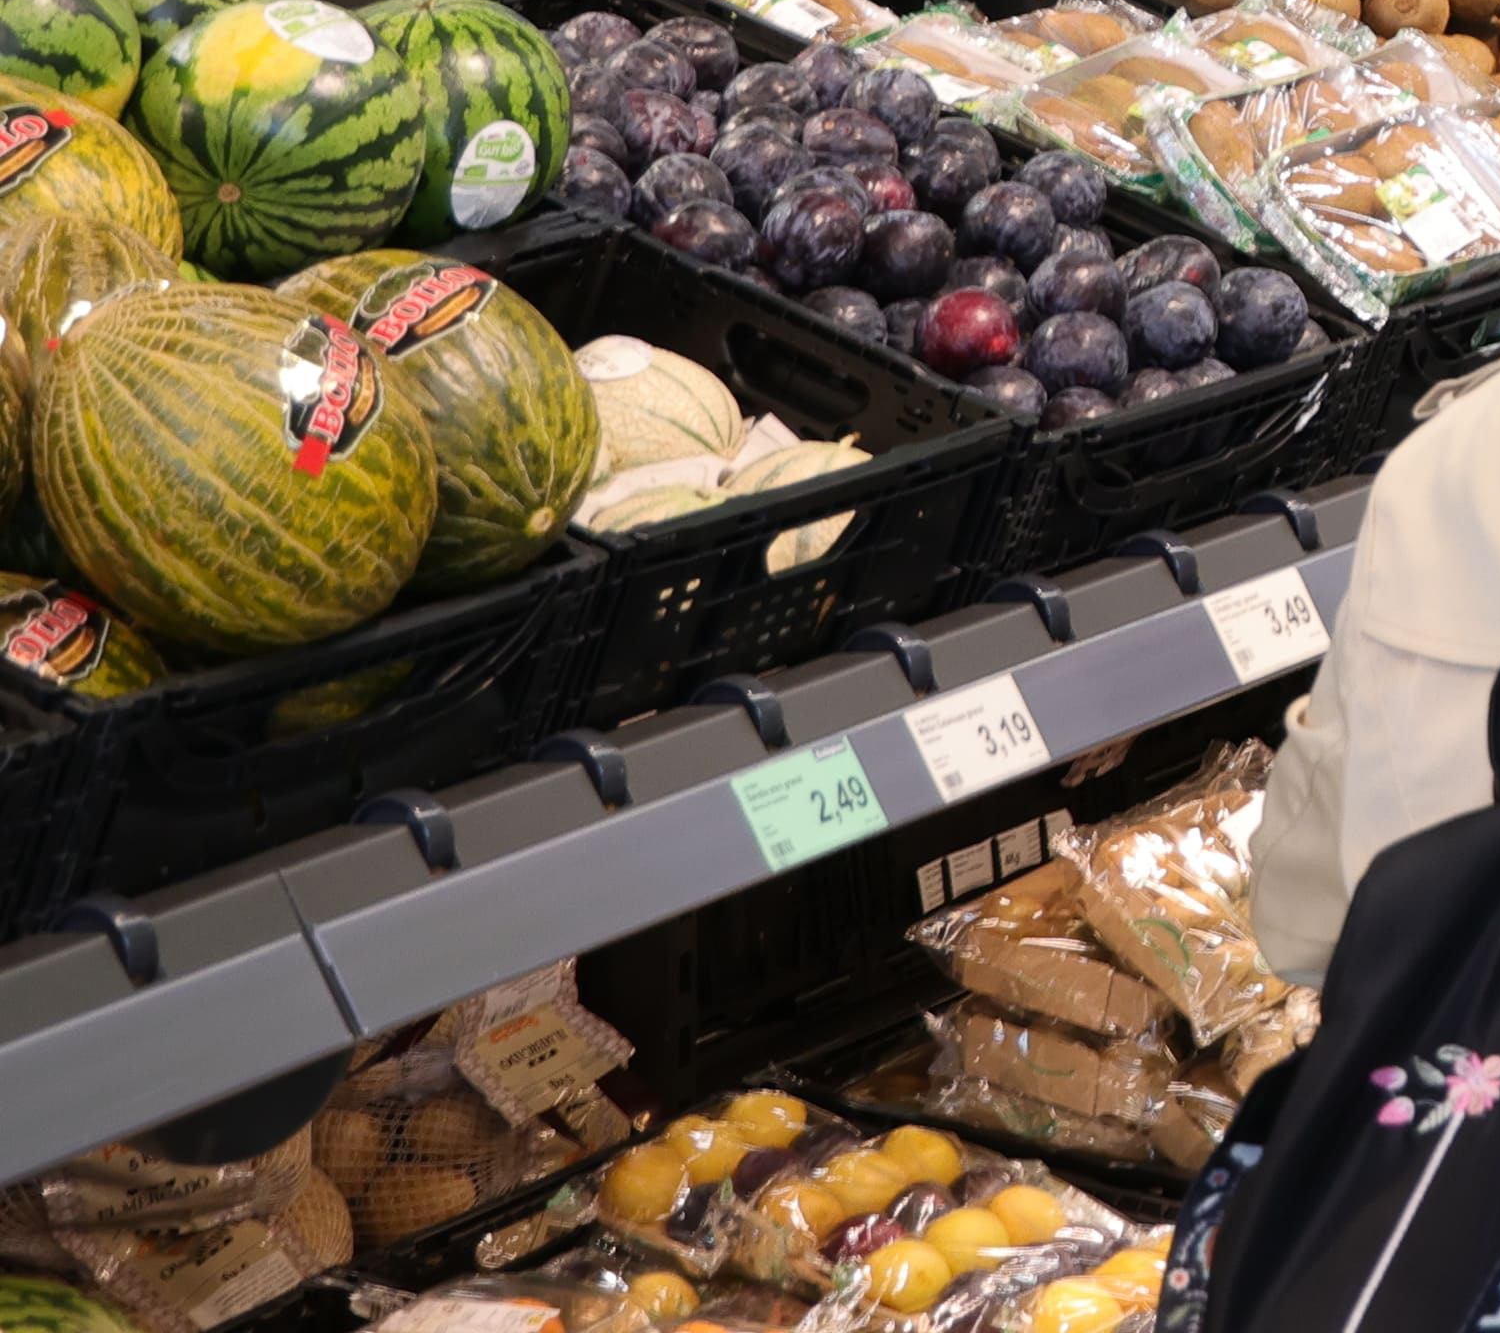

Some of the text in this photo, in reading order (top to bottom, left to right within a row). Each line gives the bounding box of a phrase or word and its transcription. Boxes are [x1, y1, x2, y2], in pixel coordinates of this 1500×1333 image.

[367, 263, 476, 346] BOLLO
[9, 596, 87, 665] OLLO
[1263, 596, 1311, 637] 3,49
[976, 711, 1032, 759] 3,19
[810, 776, 870, 825] 2,49
